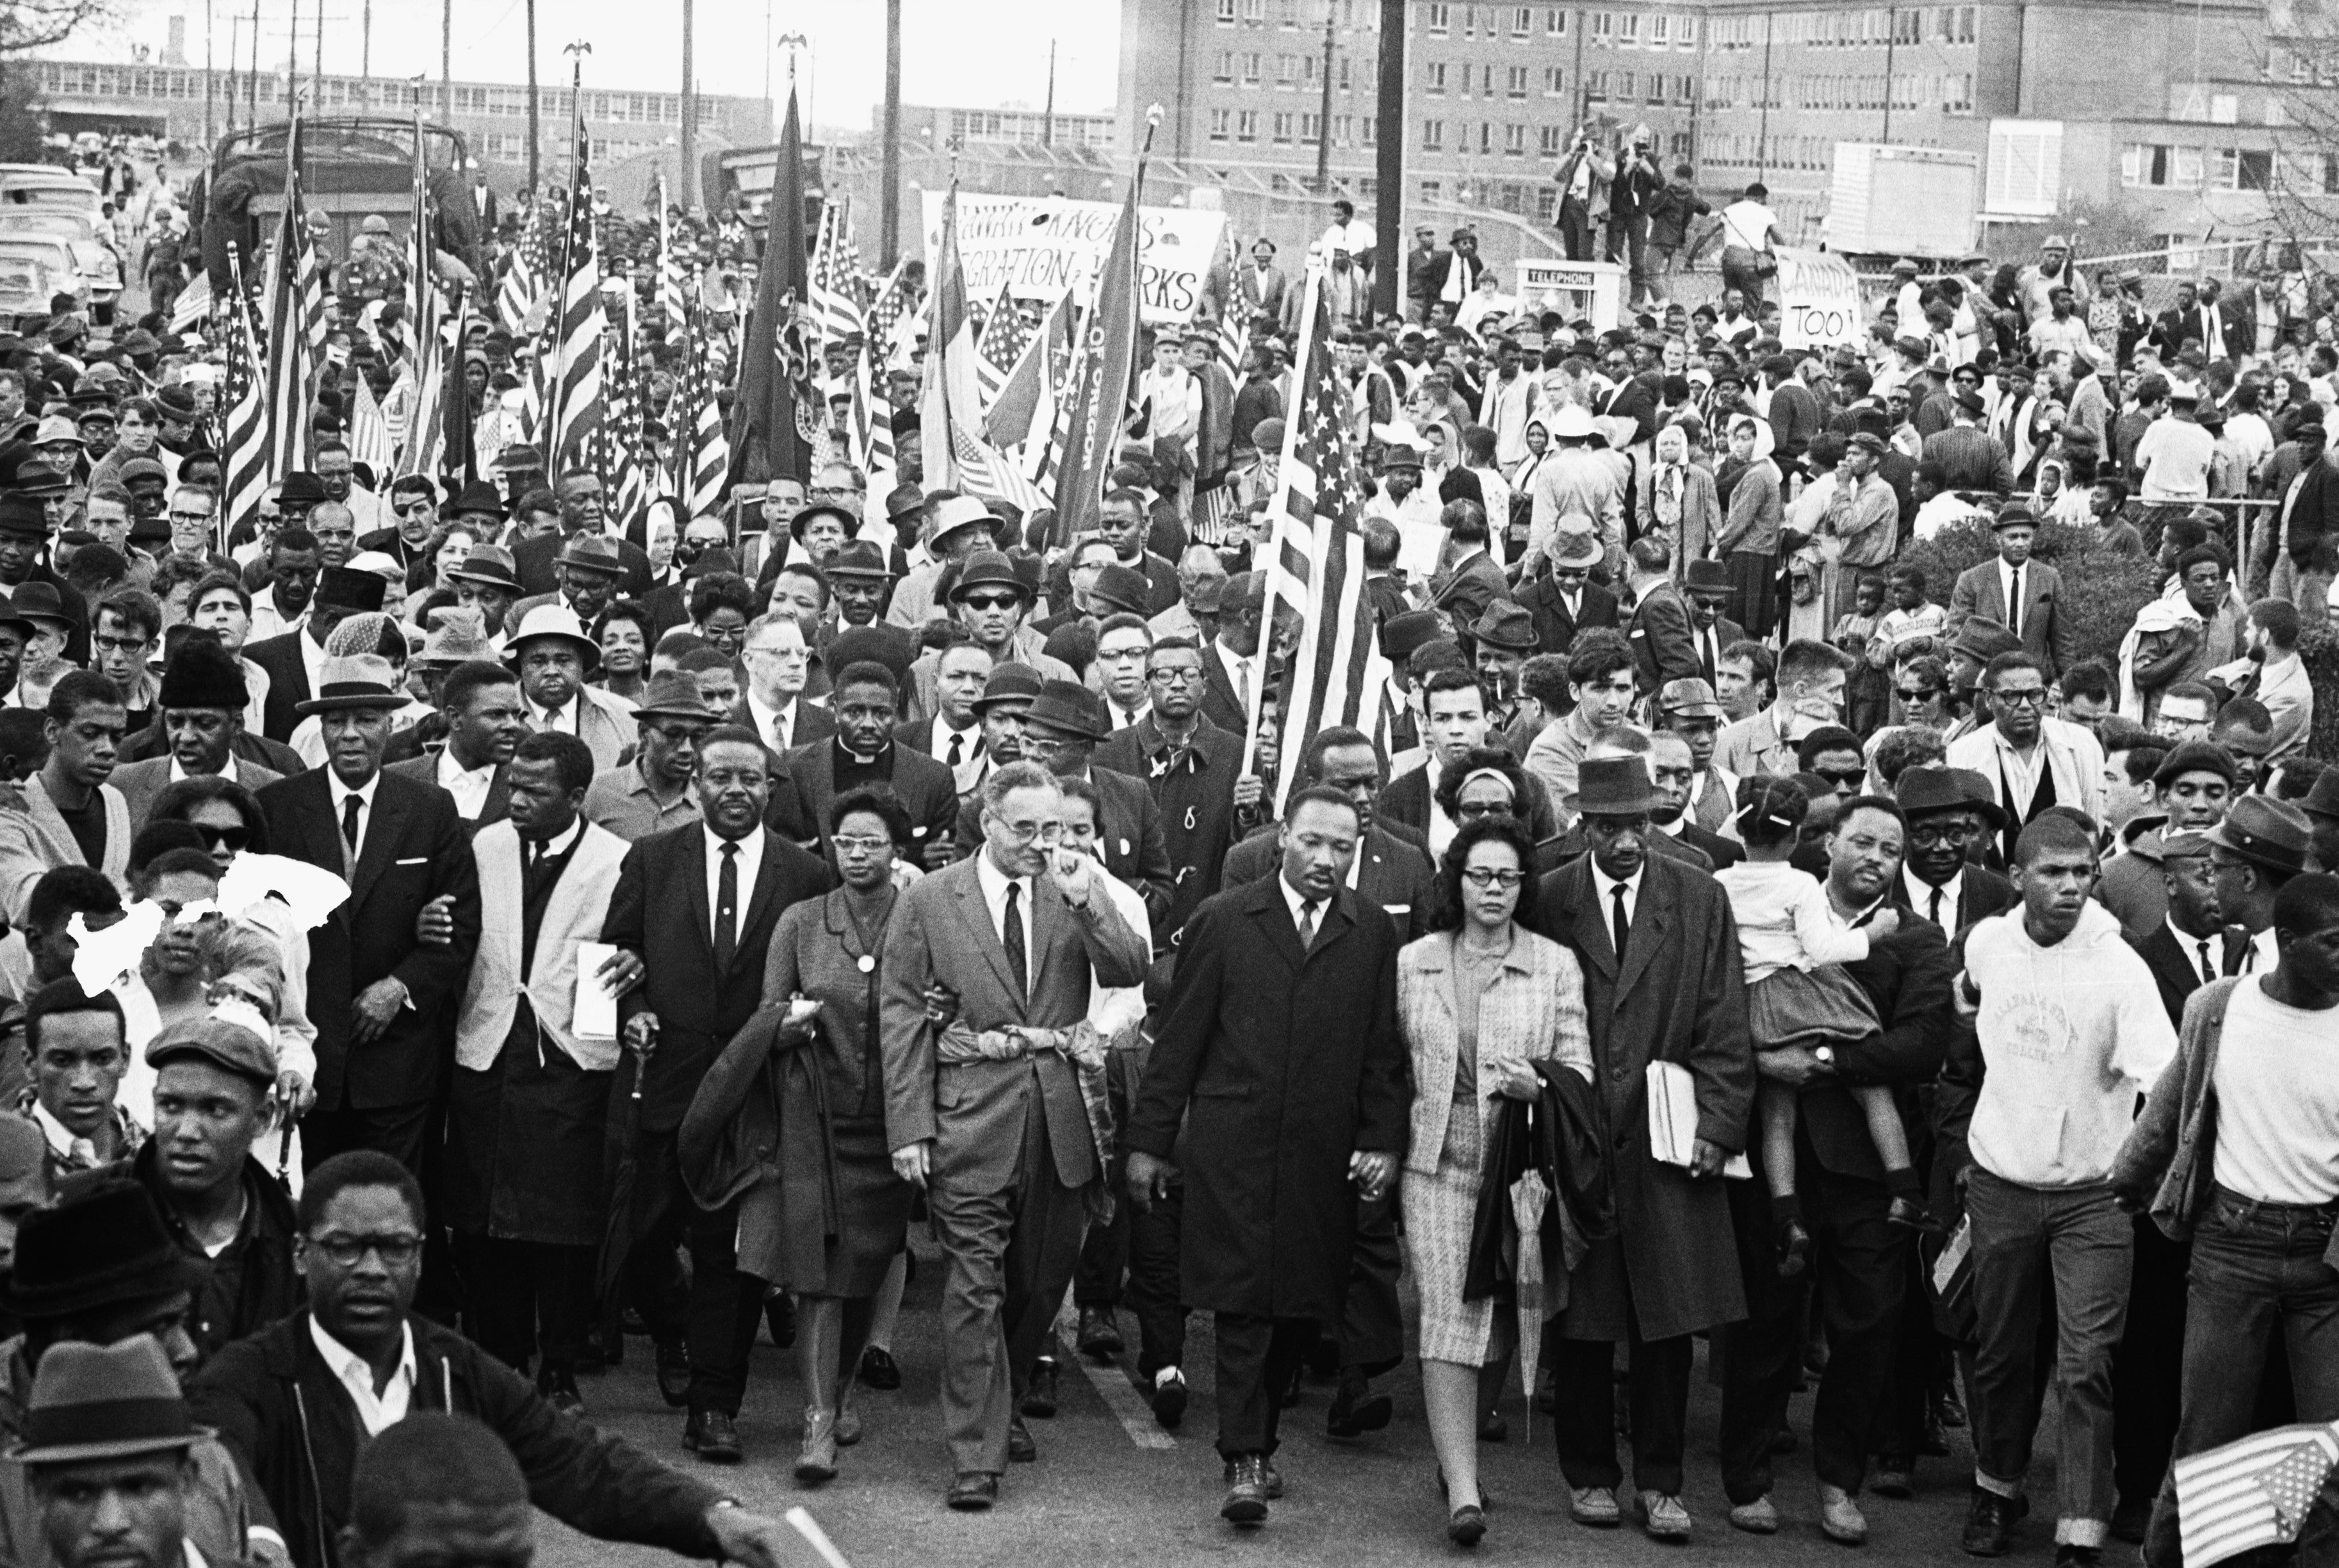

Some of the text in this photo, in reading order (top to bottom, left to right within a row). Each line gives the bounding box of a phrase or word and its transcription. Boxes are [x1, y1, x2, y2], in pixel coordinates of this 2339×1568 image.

[1046, 209, 1164, 251] KNOS
[961, 247, 1076, 288] GRATION
[1530, 271, 1593, 284] TELEPHONE
[1089, 326, 1105, 361] OF
[1082, 367, 1102, 471] OREGON
